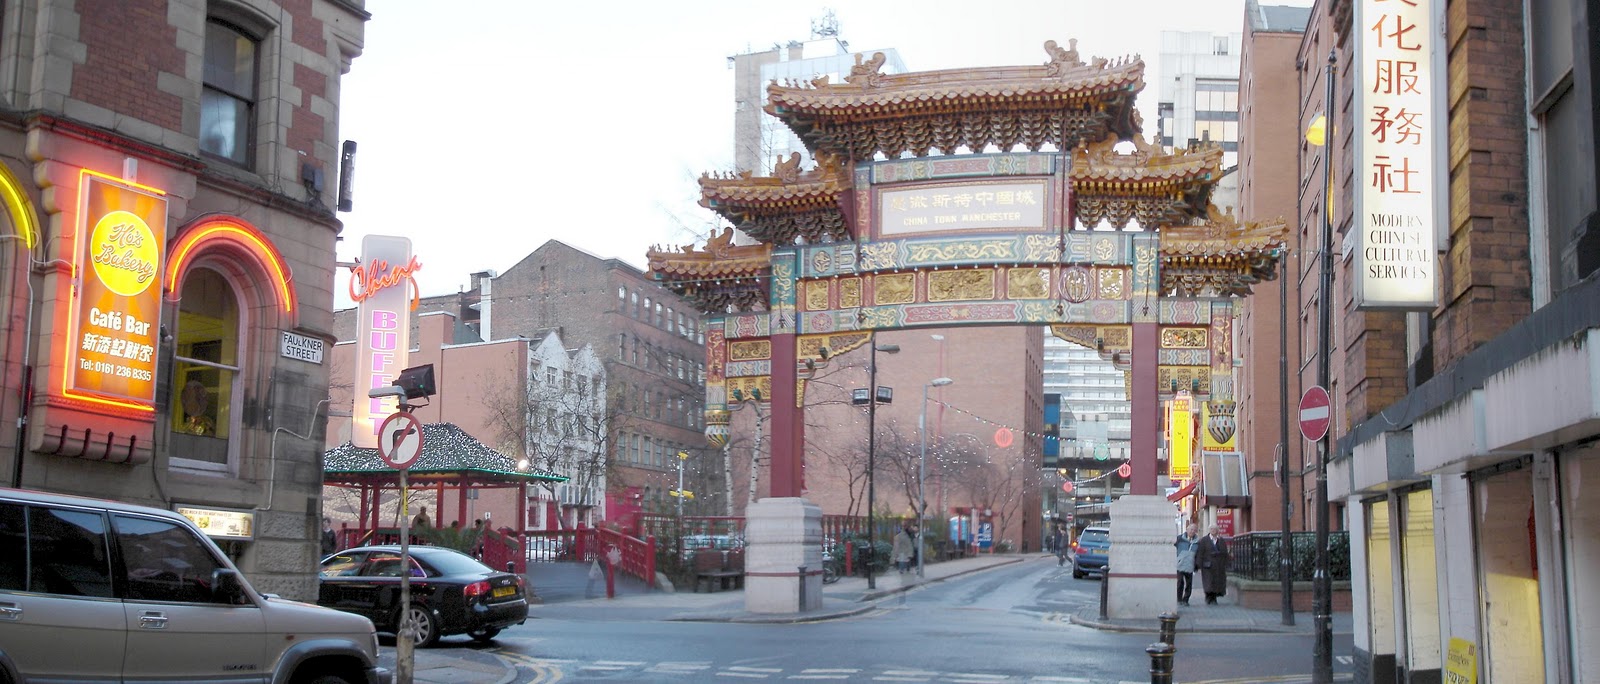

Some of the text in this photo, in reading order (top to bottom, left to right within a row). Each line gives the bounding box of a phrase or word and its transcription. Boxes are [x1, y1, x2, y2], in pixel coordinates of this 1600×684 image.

[1370, 0, 1423, 194] 化服務社
[903, 212, 1021, 227] CHINA TOWN MANCHESTER
[1371, 213, 1423, 227] MODERN
[108, 223, 144, 248] Ho's
[1370, 230, 1420, 244] CHINESE
[94, 243, 153, 283] Bakery
[1365, 247, 1430, 262] CULTURAL
[349, 254, 423, 302] China
[1369, 264, 1426, 279] SERVICES
[90, 307, 151, 336] Café Bar
[283, 334, 322, 351] FAULKNER
[286, 345, 316, 360] STREET
[80, 358, 152, 381] Tel: 0161 236 8335
